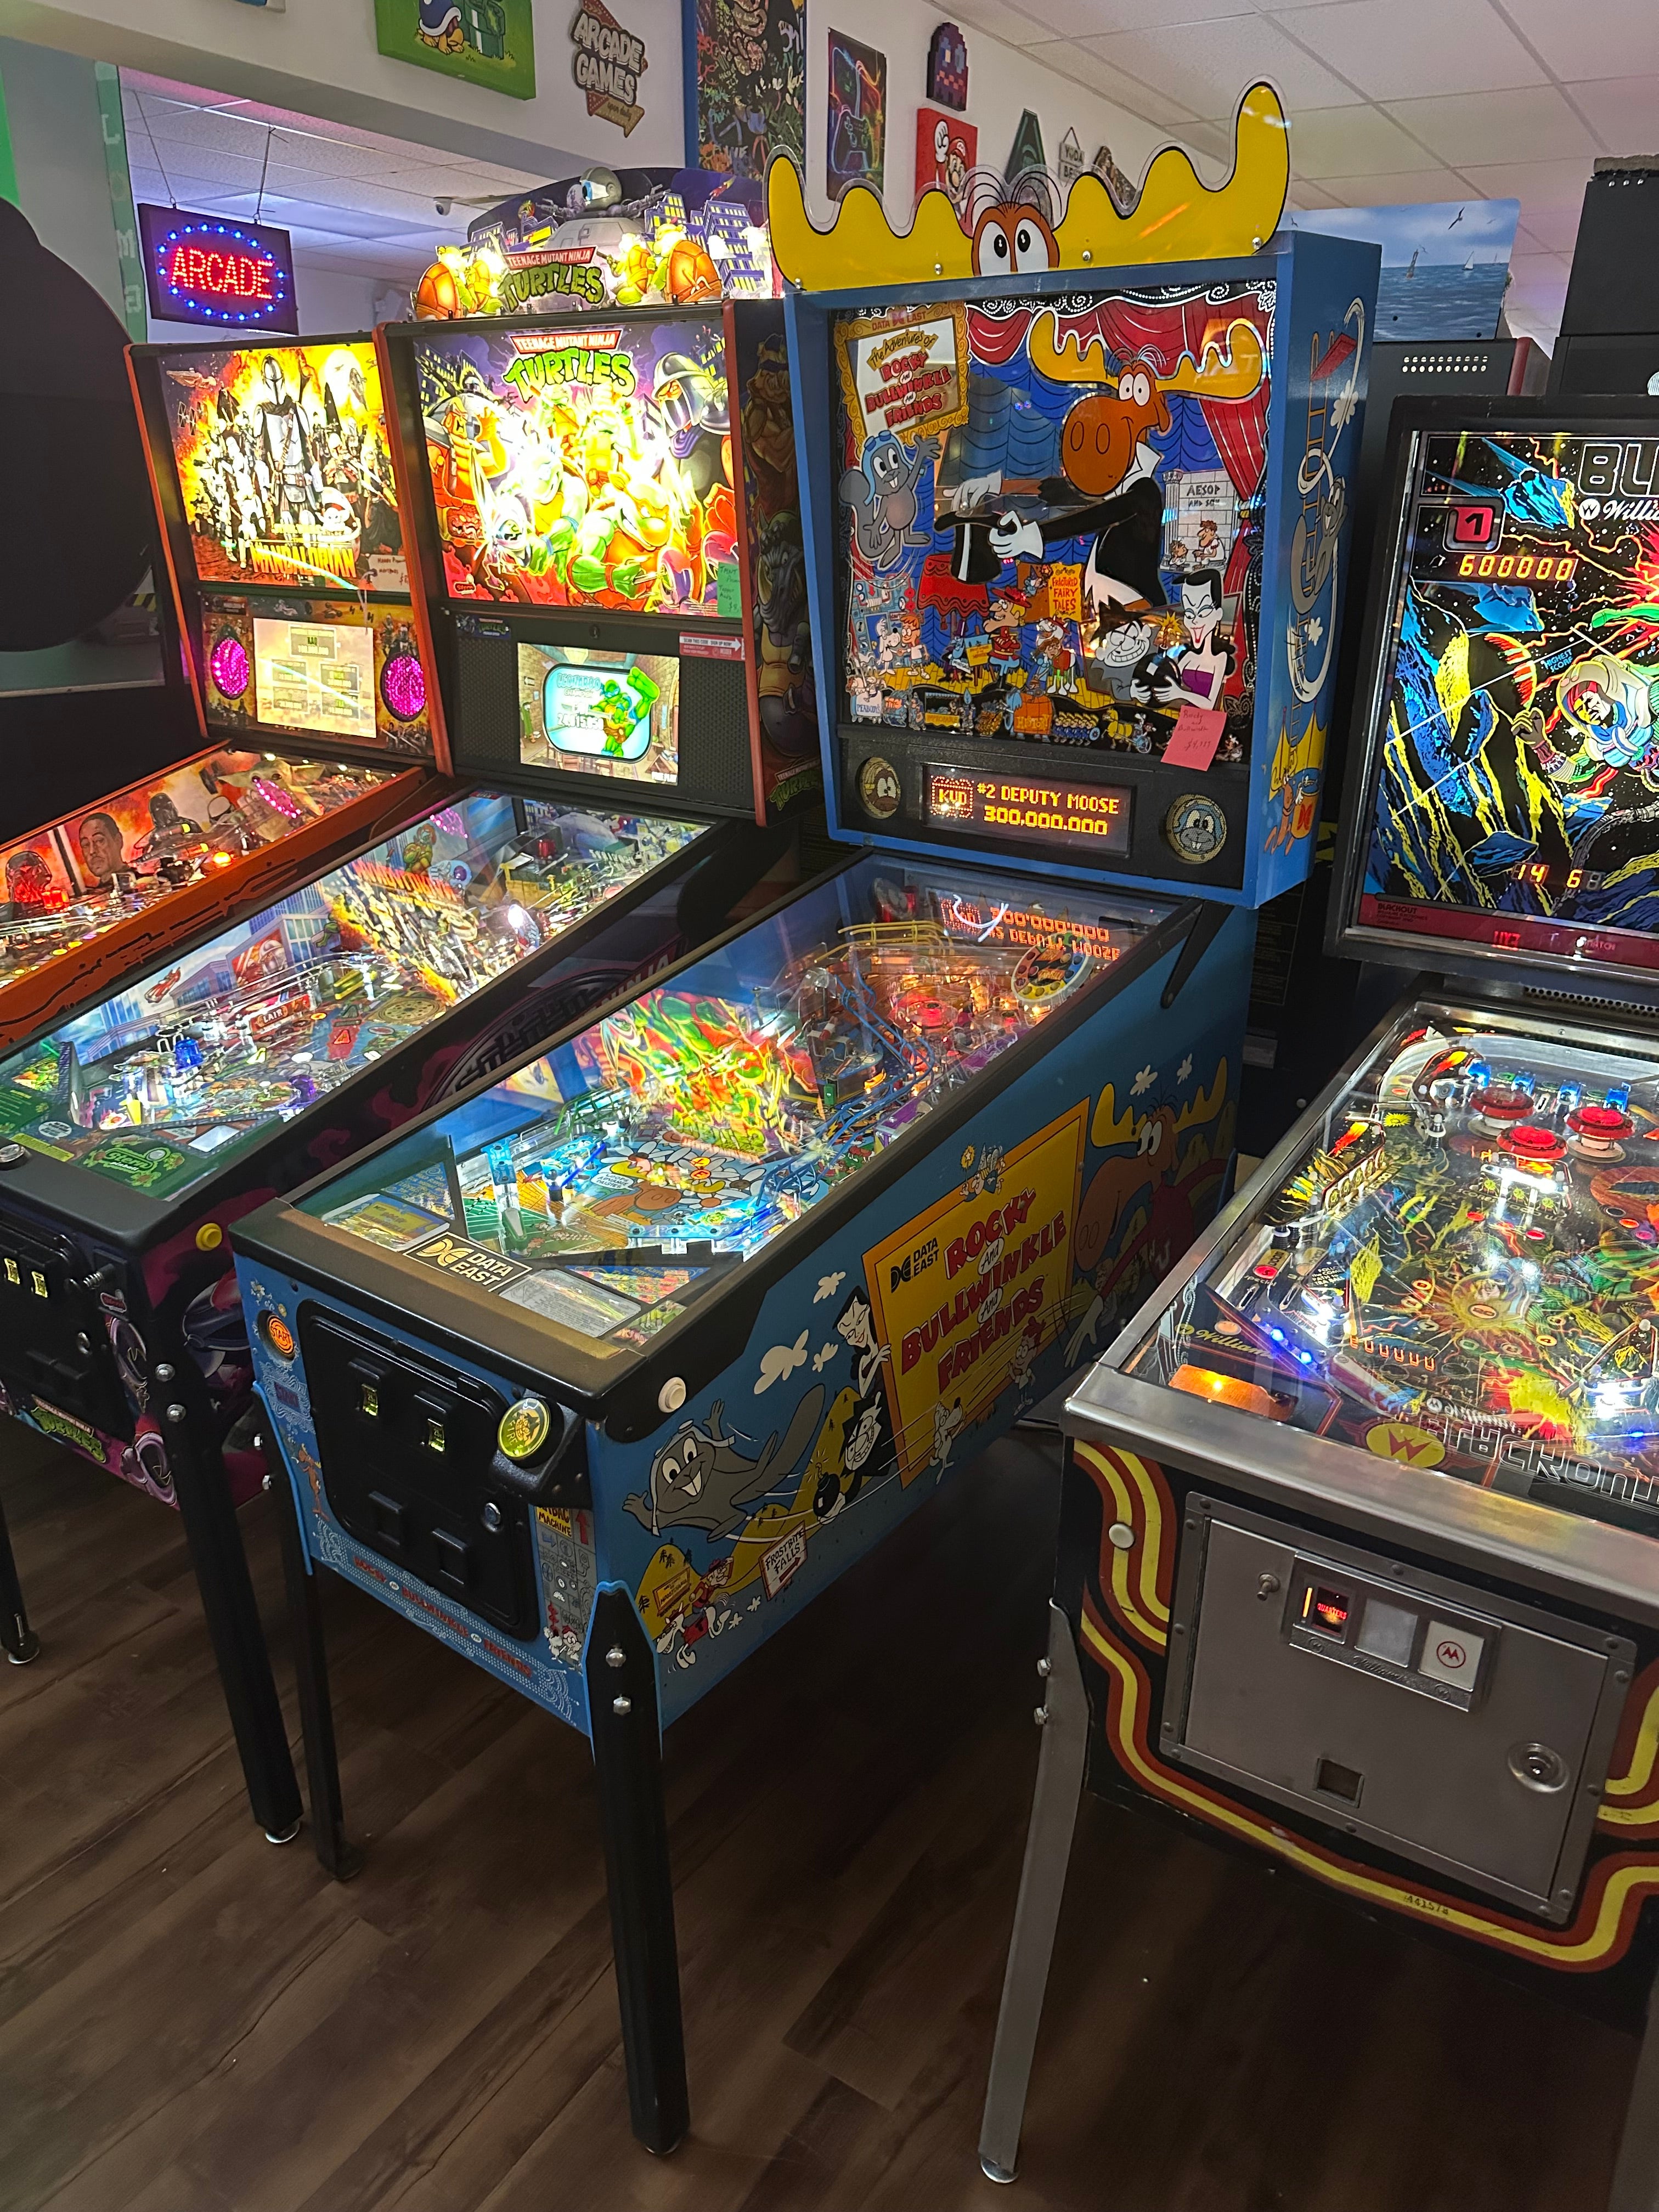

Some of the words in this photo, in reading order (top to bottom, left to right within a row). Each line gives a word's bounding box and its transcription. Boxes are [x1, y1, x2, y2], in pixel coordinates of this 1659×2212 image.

[574, 13, 642, 73] ARCADE
[577, 54, 634, 105] GAMES
[509, 255, 540, 267] TEENAGE
[543, 252, 568, 263] MUTANT
[569, 250, 591, 262] NINJA
[171, 245, 274, 300] ARCADE
[498, 262, 603, 313] TURTLES
[872, 320, 890, 331] DATA
[514, 337, 554, 351] TEENAGE
[555, 335, 588, 348] MUTANT
[588, 334, 616, 346] NINJA
[503, 346, 636, 402] TURTLES
[880, 351, 928, 382] ROCKY
[866, 366, 952, 412] BULLWINKLE
[885, 392, 942, 428] FRIENDS
[1578, 443, 1659, 498] BL
[1187, 484, 1220, 496] AESOP
[1602, 500, 1659, 520] Willi
[1465, 513, 1483, 536] 1
[250, 541, 356, 578] MANDALORIAN
[1459, 555, 1573, 580] 600000
[1052, 577, 1077, 587] FRACTURED
[1053, 598, 1076, 611] TALES
[1544, 648, 1572, 669] HIGHEST
[1550, 656, 1573, 673] SCORE
[557, 673, 601, 690] LEONARDO
[977, 782, 996, 799] #2
[1001, 785, 1062, 807] DEPUTY
[1067, 793, 1120, 815] MOOSE
[1378, 903, 1418, 914] BLACKOUT
[263, 1008, 283, 1023] LAIR
[106, 1149, 151, 1169] Stern
[109, 1161, 139, 1172] pinball
[596, 1181, 622, 1189] DAISIES
[597, 1177, 629, 1186] ADVANCE
[606, 1173, 629, 1183] LOOPS
[944, 1187, 1036, 1279] ROCKY
[913, 1238, 939, 1263] DATA
[449, 1261, 501, 1285] EAST
[466, 1253, 514, 1277] DATA
[912, 1249, 939, 1278] EAST
[901, 1211, 1066, 1375] BULLWINKLE
[271, 1326, 291, 1345] START
[938, 1274, 1045, 1395] FRIENDS
[506, 1420, 518, 1446] FIRE
[538, 1513, 572, 1537] MACHINE
[765, 1528, 804, 1571] FROSTBITE
[774, 1543, 800, 1575] FALLS
[1317, 1602, 1347, 1620] QUARTERS
